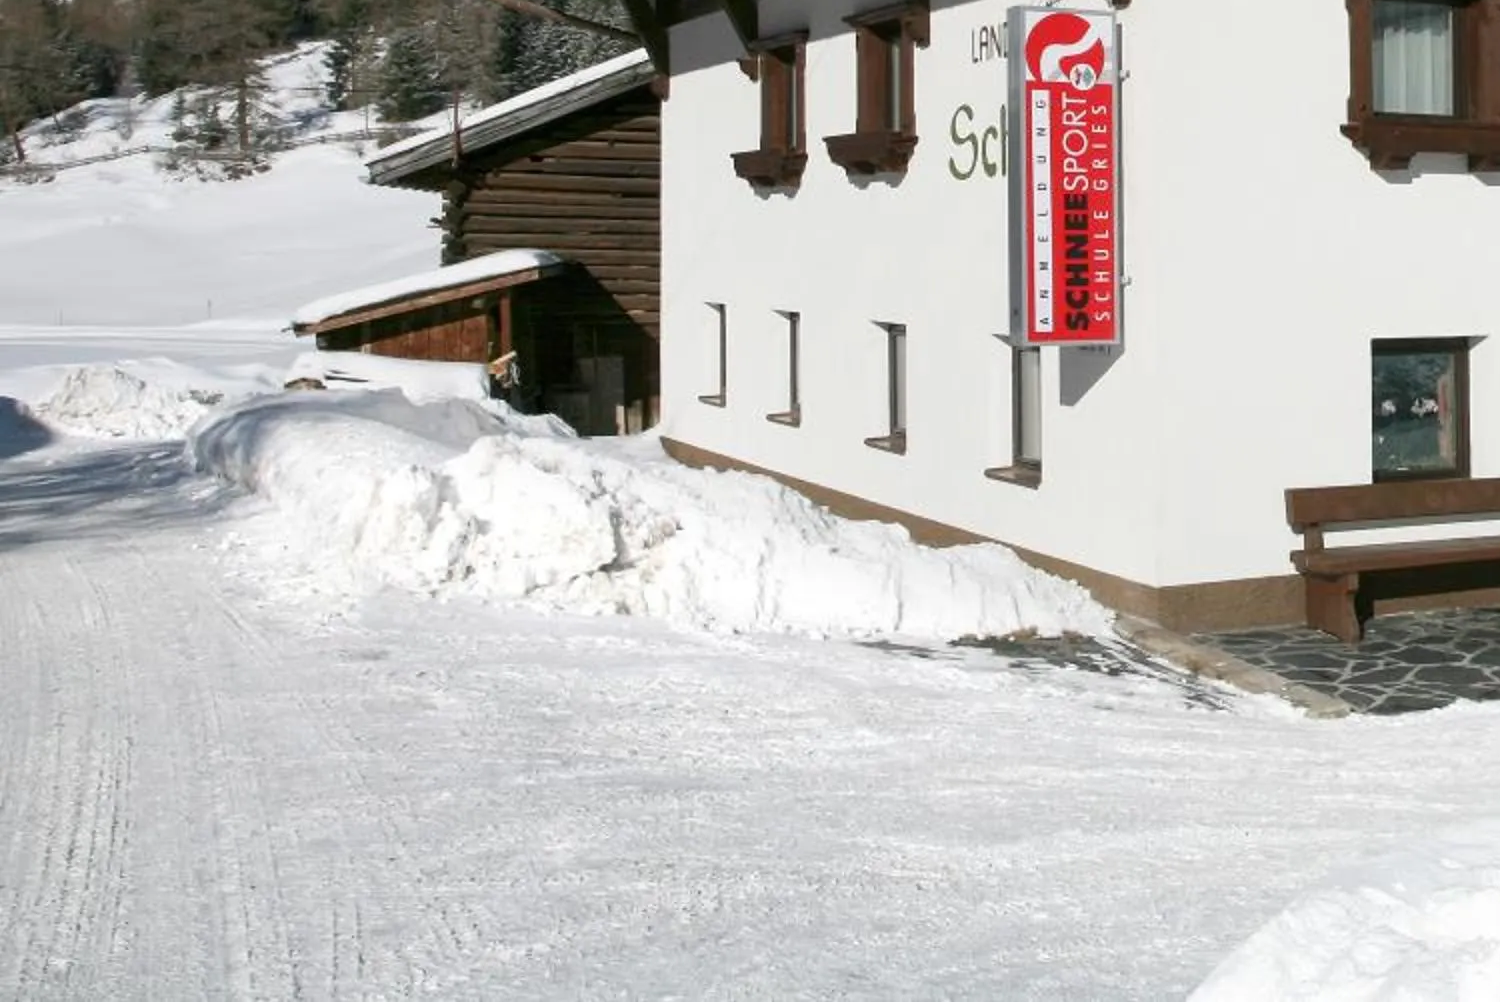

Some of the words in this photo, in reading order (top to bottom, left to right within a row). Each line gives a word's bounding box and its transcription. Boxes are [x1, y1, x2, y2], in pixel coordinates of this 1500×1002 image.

[1036, 99, 1050, 326] ANMELDUNG
[1061, 91, 1090, 331] SCHNEESPORT
[1091, 105, 1109, 192] GRIES
[1093, 209, 1111, 322] SCHULE
